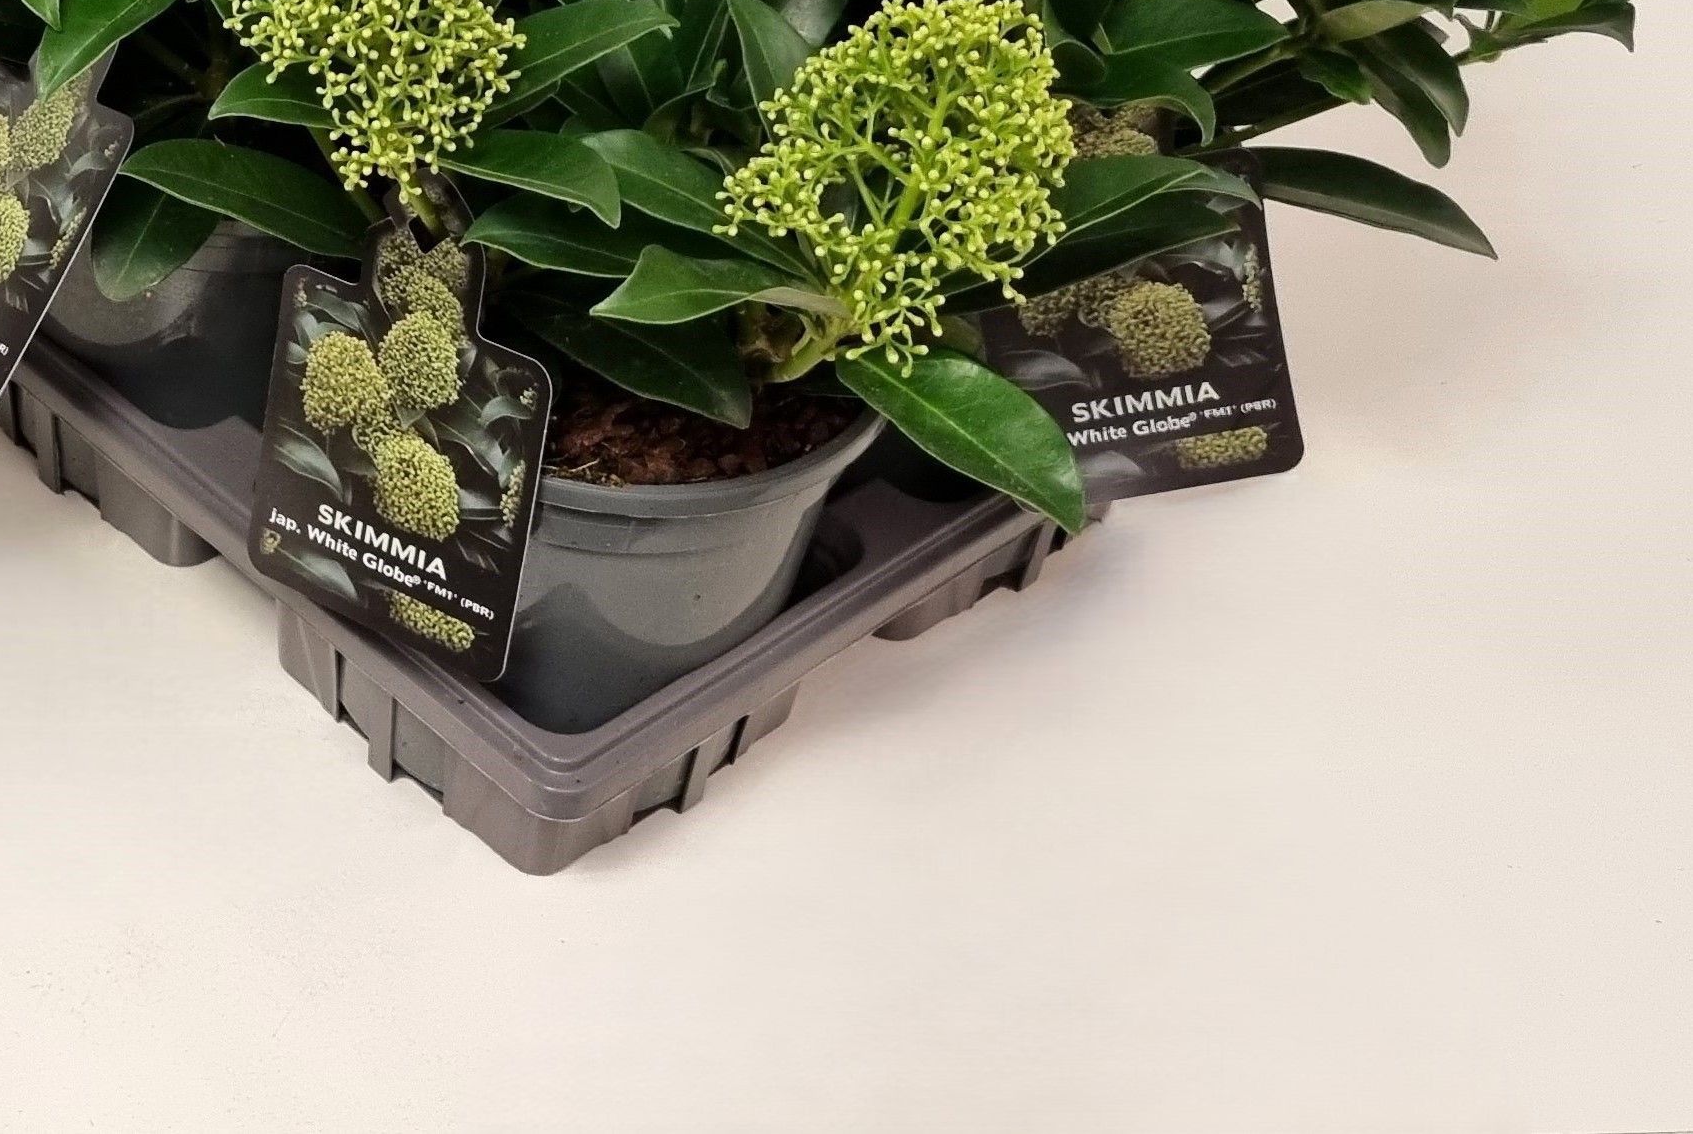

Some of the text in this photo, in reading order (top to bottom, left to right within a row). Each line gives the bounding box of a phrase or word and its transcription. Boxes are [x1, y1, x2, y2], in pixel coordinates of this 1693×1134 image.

[1071, 381, 1220, 423] SKIMMIA
[1066, 425, 1127, 447] White
[269, 507, 301, 534] jap.
[307, 524, 357, 560] White
[460, 597, 495, 620] (PBR)
[317, 504, 447, 580] SKIMMIA
